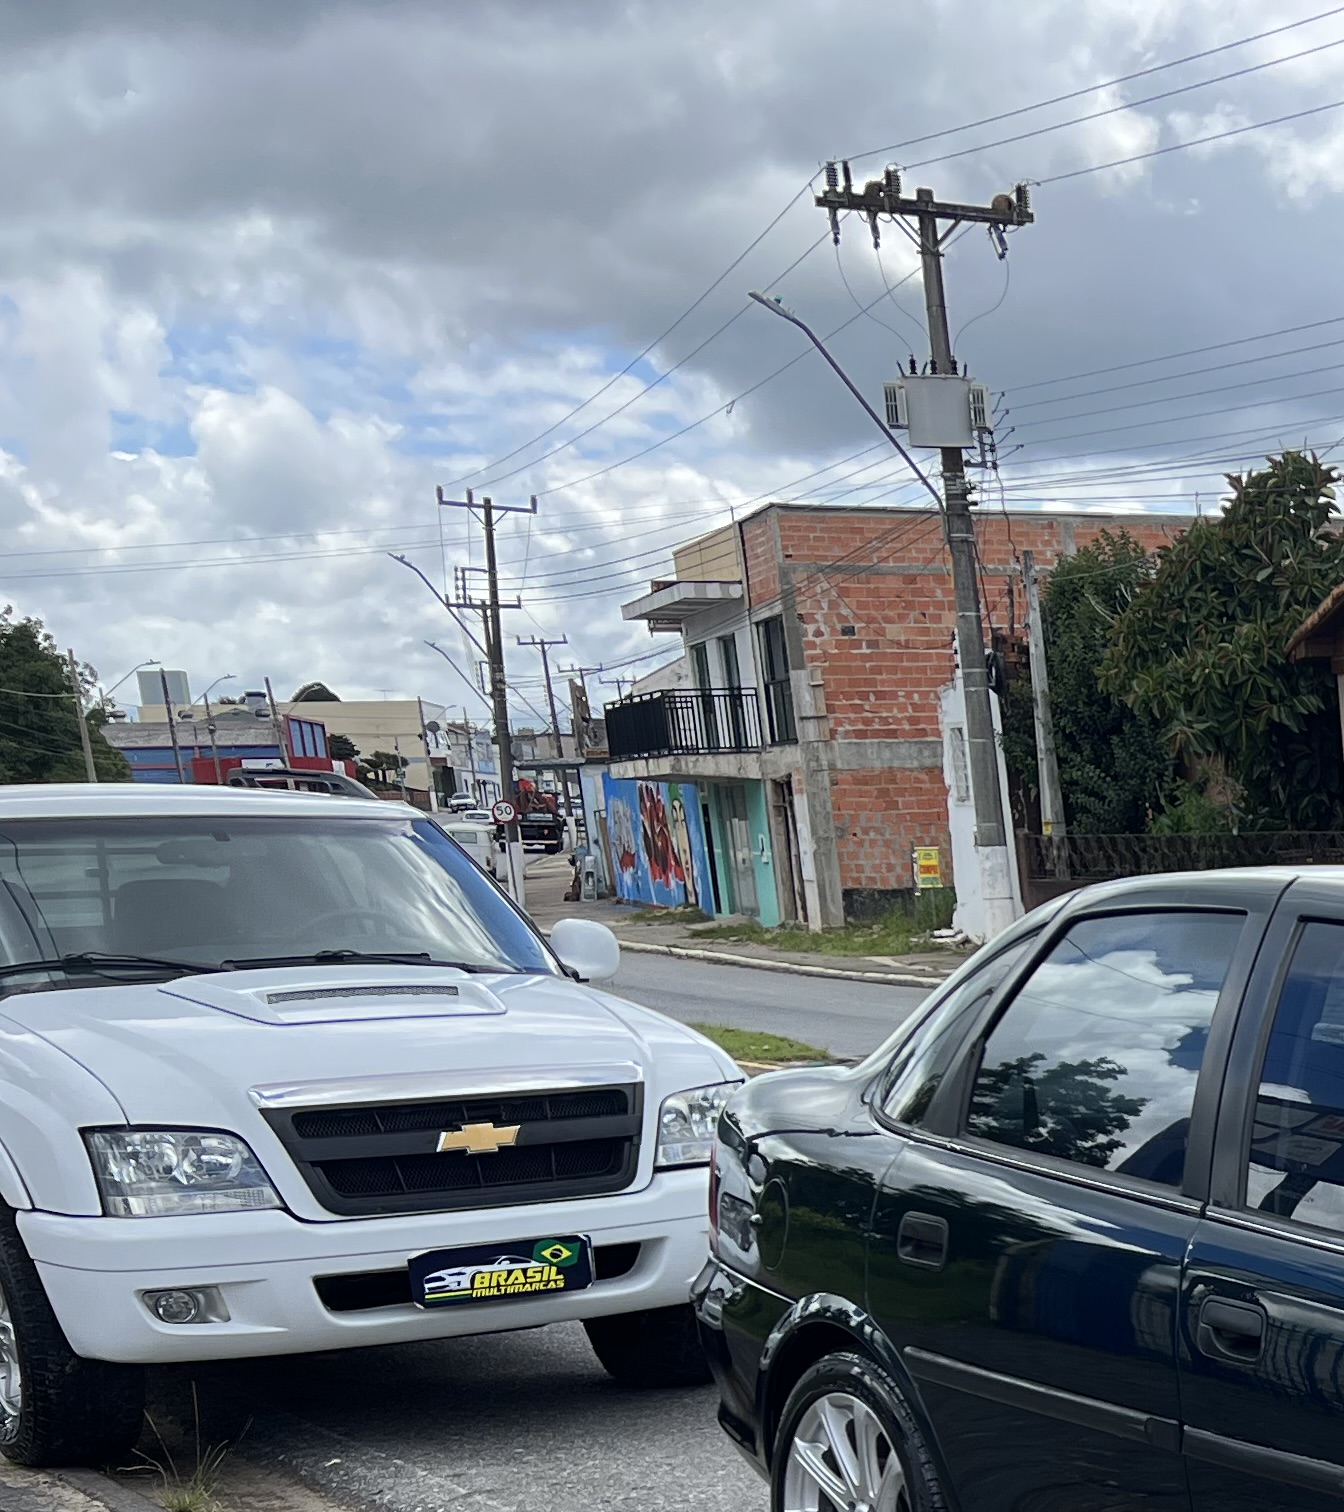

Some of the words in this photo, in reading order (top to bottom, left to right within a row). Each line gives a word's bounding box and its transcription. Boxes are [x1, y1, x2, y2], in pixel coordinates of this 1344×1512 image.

[496, 806, 512, 816] 50
[474, 1266, 564, 1288] BRASIL
[472, 1280, 565, 1298] MULTIMARCAS
